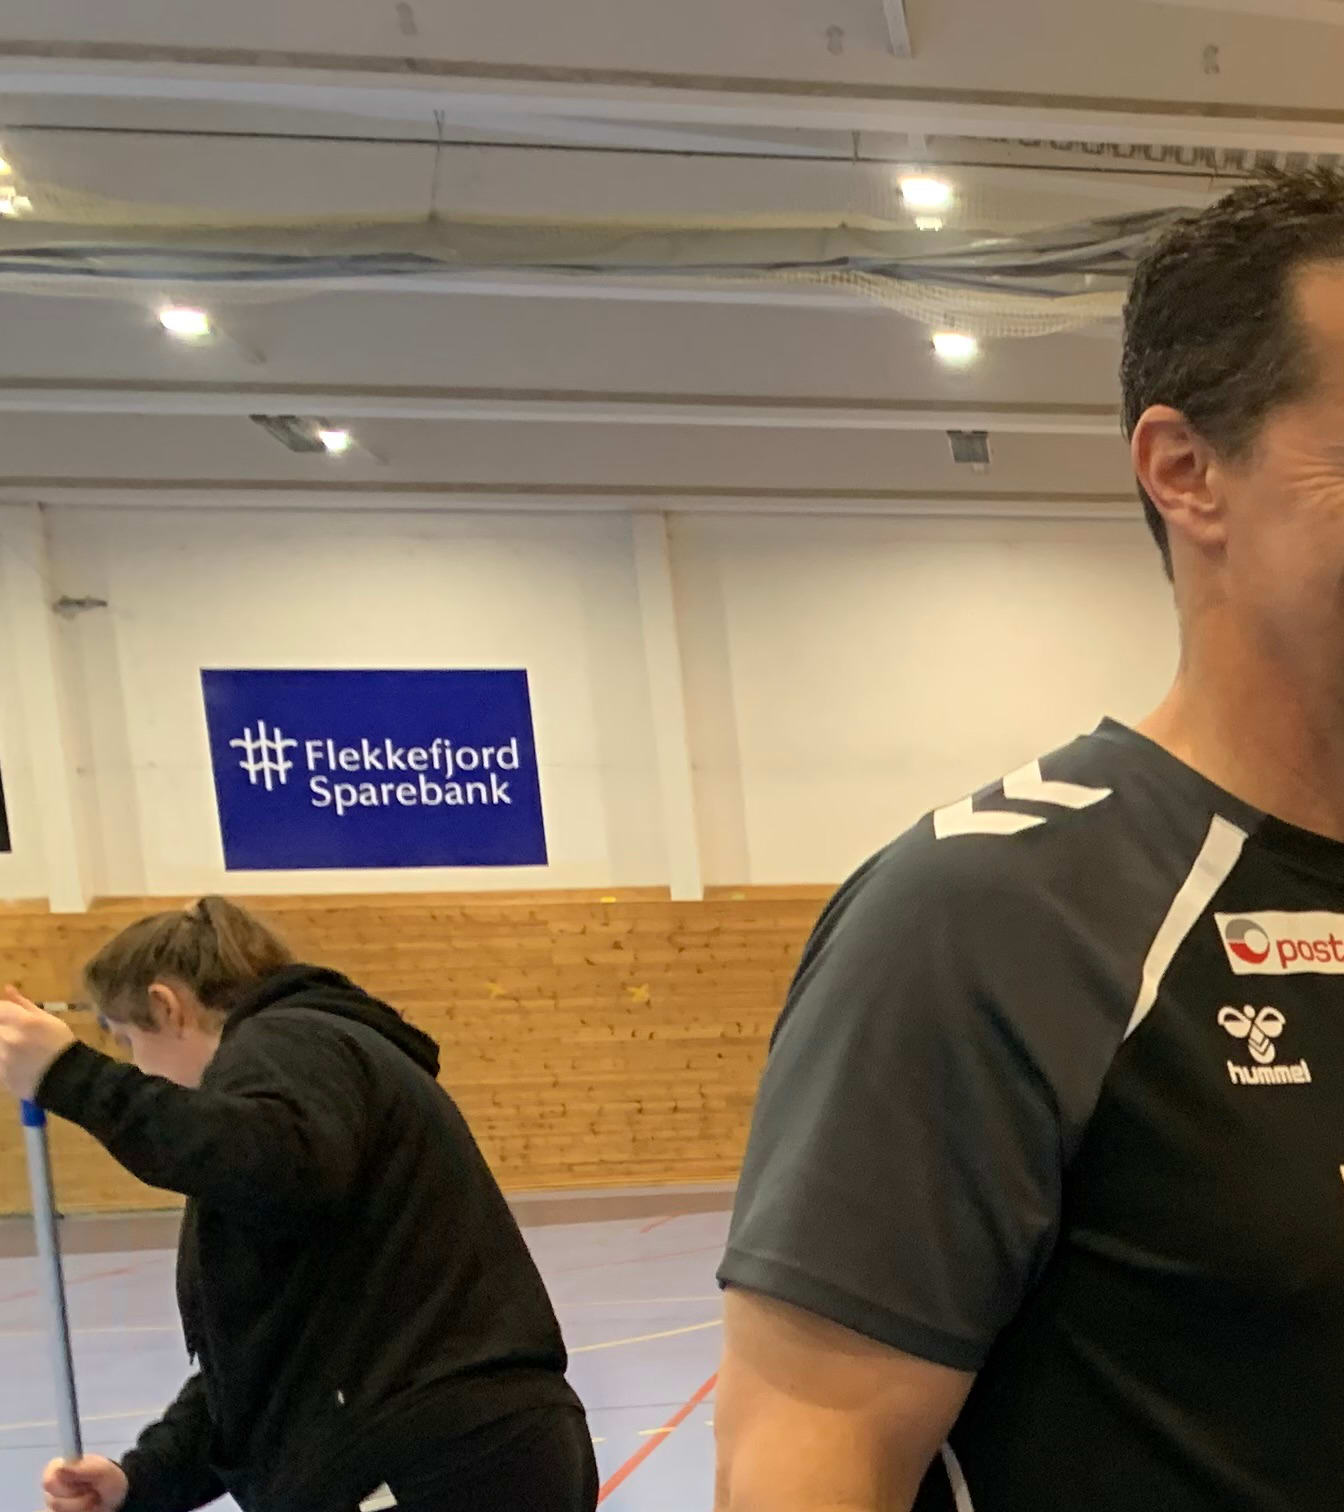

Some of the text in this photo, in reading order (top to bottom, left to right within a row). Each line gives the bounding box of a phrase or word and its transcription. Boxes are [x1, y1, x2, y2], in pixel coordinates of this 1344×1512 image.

[305, 738, 520, 779] Flekkefjord
[309, 773, 512, 816] Sparebank
[1227, 1058, 1312, 1085] hummel
